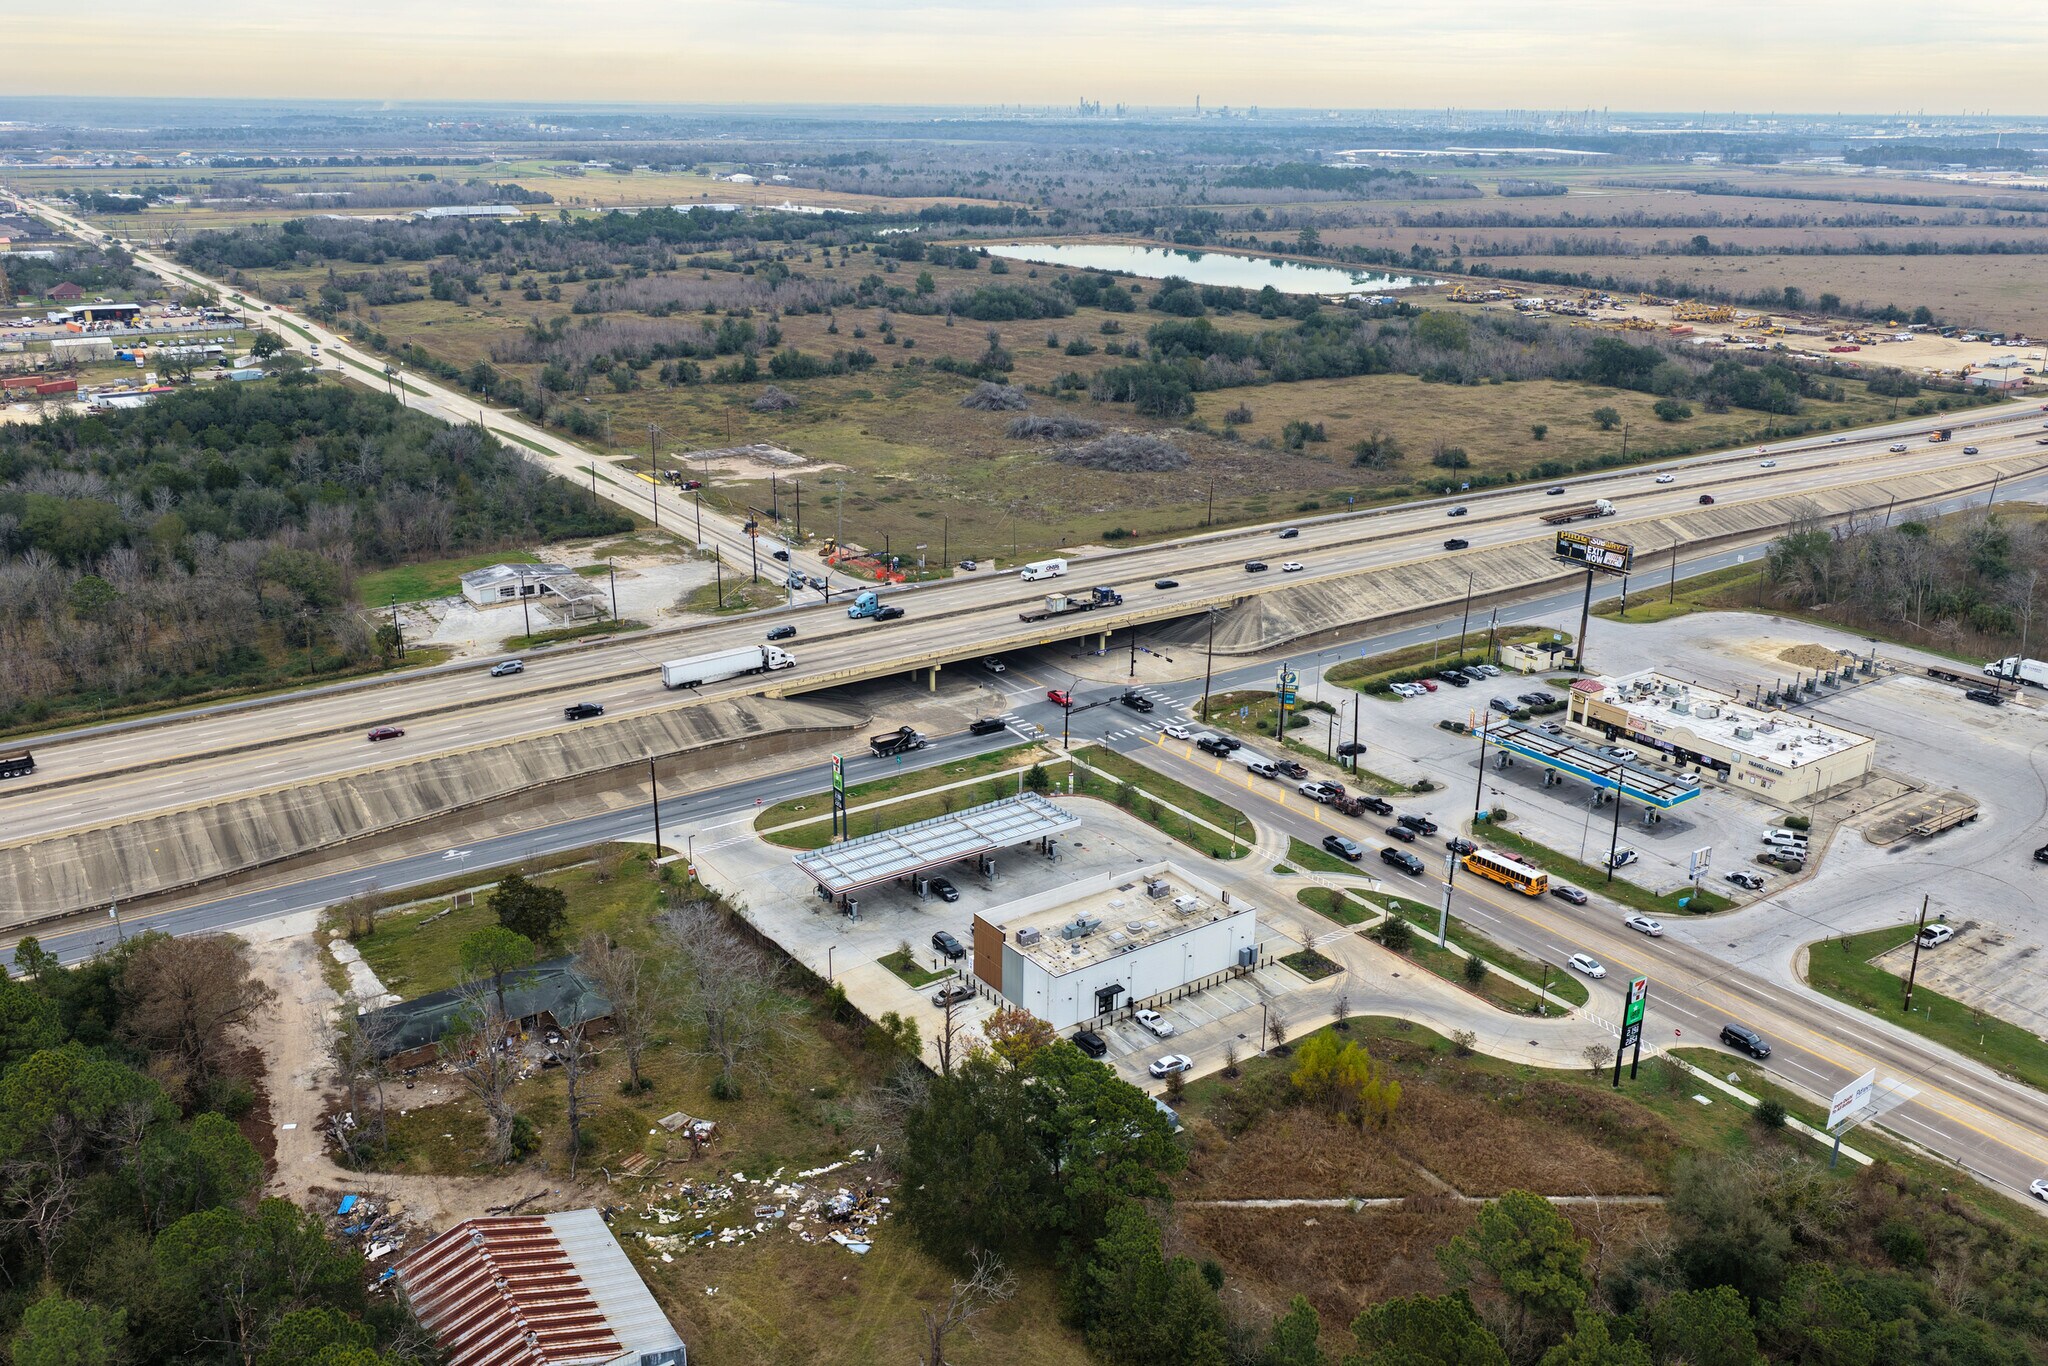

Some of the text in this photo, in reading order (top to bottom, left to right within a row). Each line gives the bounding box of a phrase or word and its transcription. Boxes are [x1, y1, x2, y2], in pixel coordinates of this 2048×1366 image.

[1587, 546, 1604, 556] EXIT
[1586, 553, 1603, 564] NOW
[1748, 760, 1784, 776] TRAVEL CENTER
